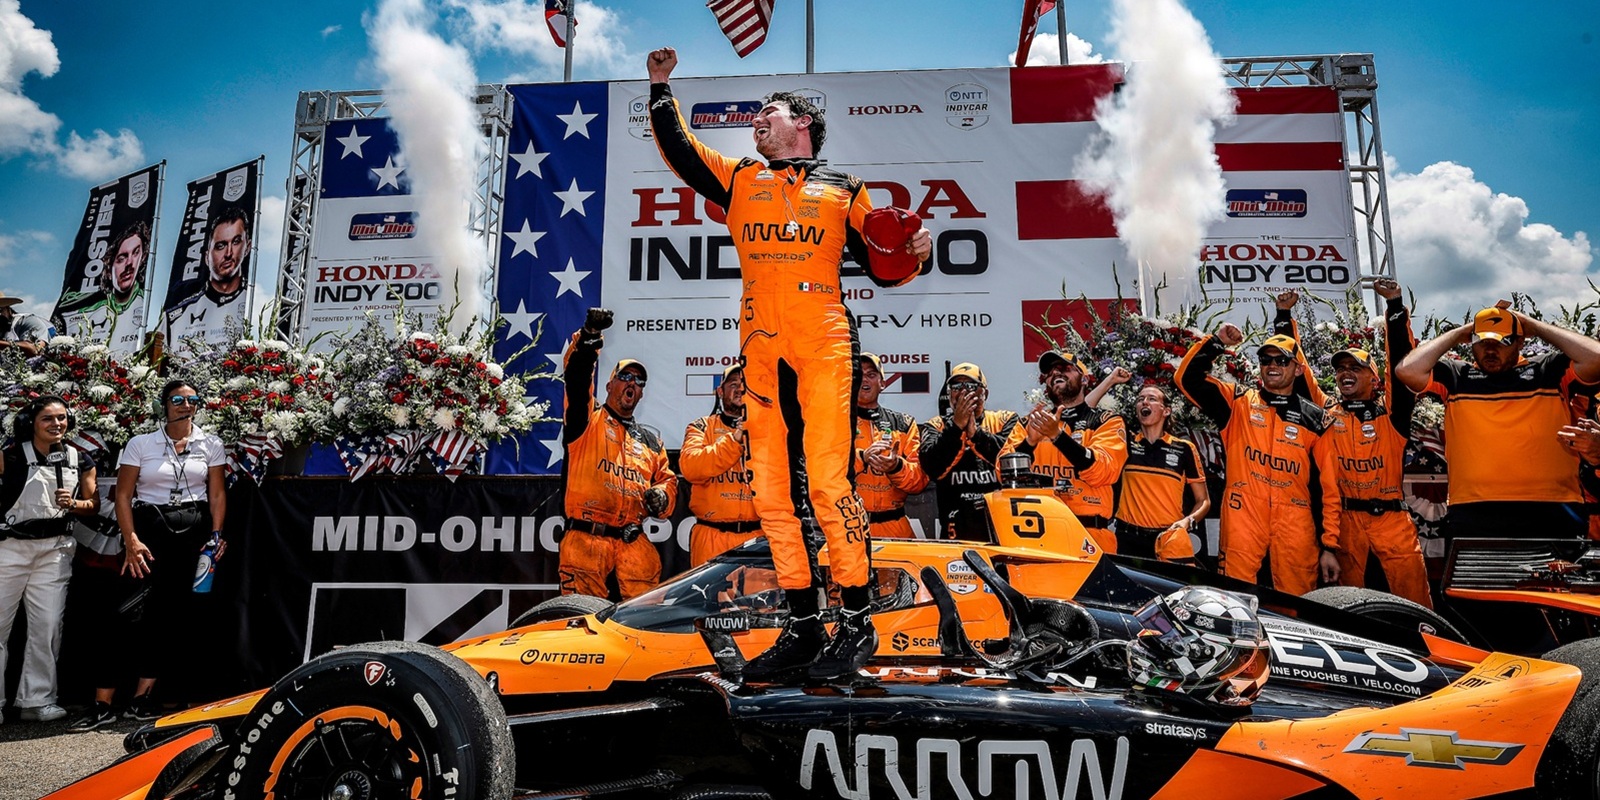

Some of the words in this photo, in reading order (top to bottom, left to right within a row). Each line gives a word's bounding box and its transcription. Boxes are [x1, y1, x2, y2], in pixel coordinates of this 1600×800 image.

[962, 91, 983, 100] NTT
[848, 104, 924, 115] HONDA
[946, 103, 988, 112] INDYCAR
[628, 115, 650, 123] INDY
[86, 196, 100, 229] LOUIS
[183, 189, 199, 235] GRAHAM
[82, 191, 118, 294] FOSTER
[183, 186, 214, 281] RAHAL
[742, 222, 825, 245] ARROW
[628, 234, 743, 281] IND
[748, 252, 807, 261] REYNOLDS
[1199, 244, 1348, 262] HONDA
[316, 262, 442, 282] HONDA
[1284, 264, 1350, 285] 200
[313, 283, 382, 304] INDY
[386, 281, 442, 301] 200
[1253, 296, 1267, 304] THE
[744, 298, 755, 321] 5
[626, 318, 717, 332] PRESENTED
[722, 317, 740, 331] BY
[858, 314, 914, 328] R-V
[921, 313, 992, 328] HYBRID
[685, 356, 741, 367] MID-OH
[878, 353, 931, 365] OURSE
[1244, 445, 1301, 475] ARROW
[1228, 492, 1243, 510] 5
[1010, 497, 1046, 539] 5
[311, 515, 566, 553] MID-OHIO
[947, 522, 957, 540] 5
[704, 617, 744, 629] ARROW
[540, 652, 569, 662] NTT
[1267, 631, 1429, 683] ELO
[1293, 668, 1348, 684] POUCHES
[1362, 678, 1422, 696] VELO.COM
[1145, 720, 1207, 740] stratasys
[800, 728, 1130, 800] ARROW
